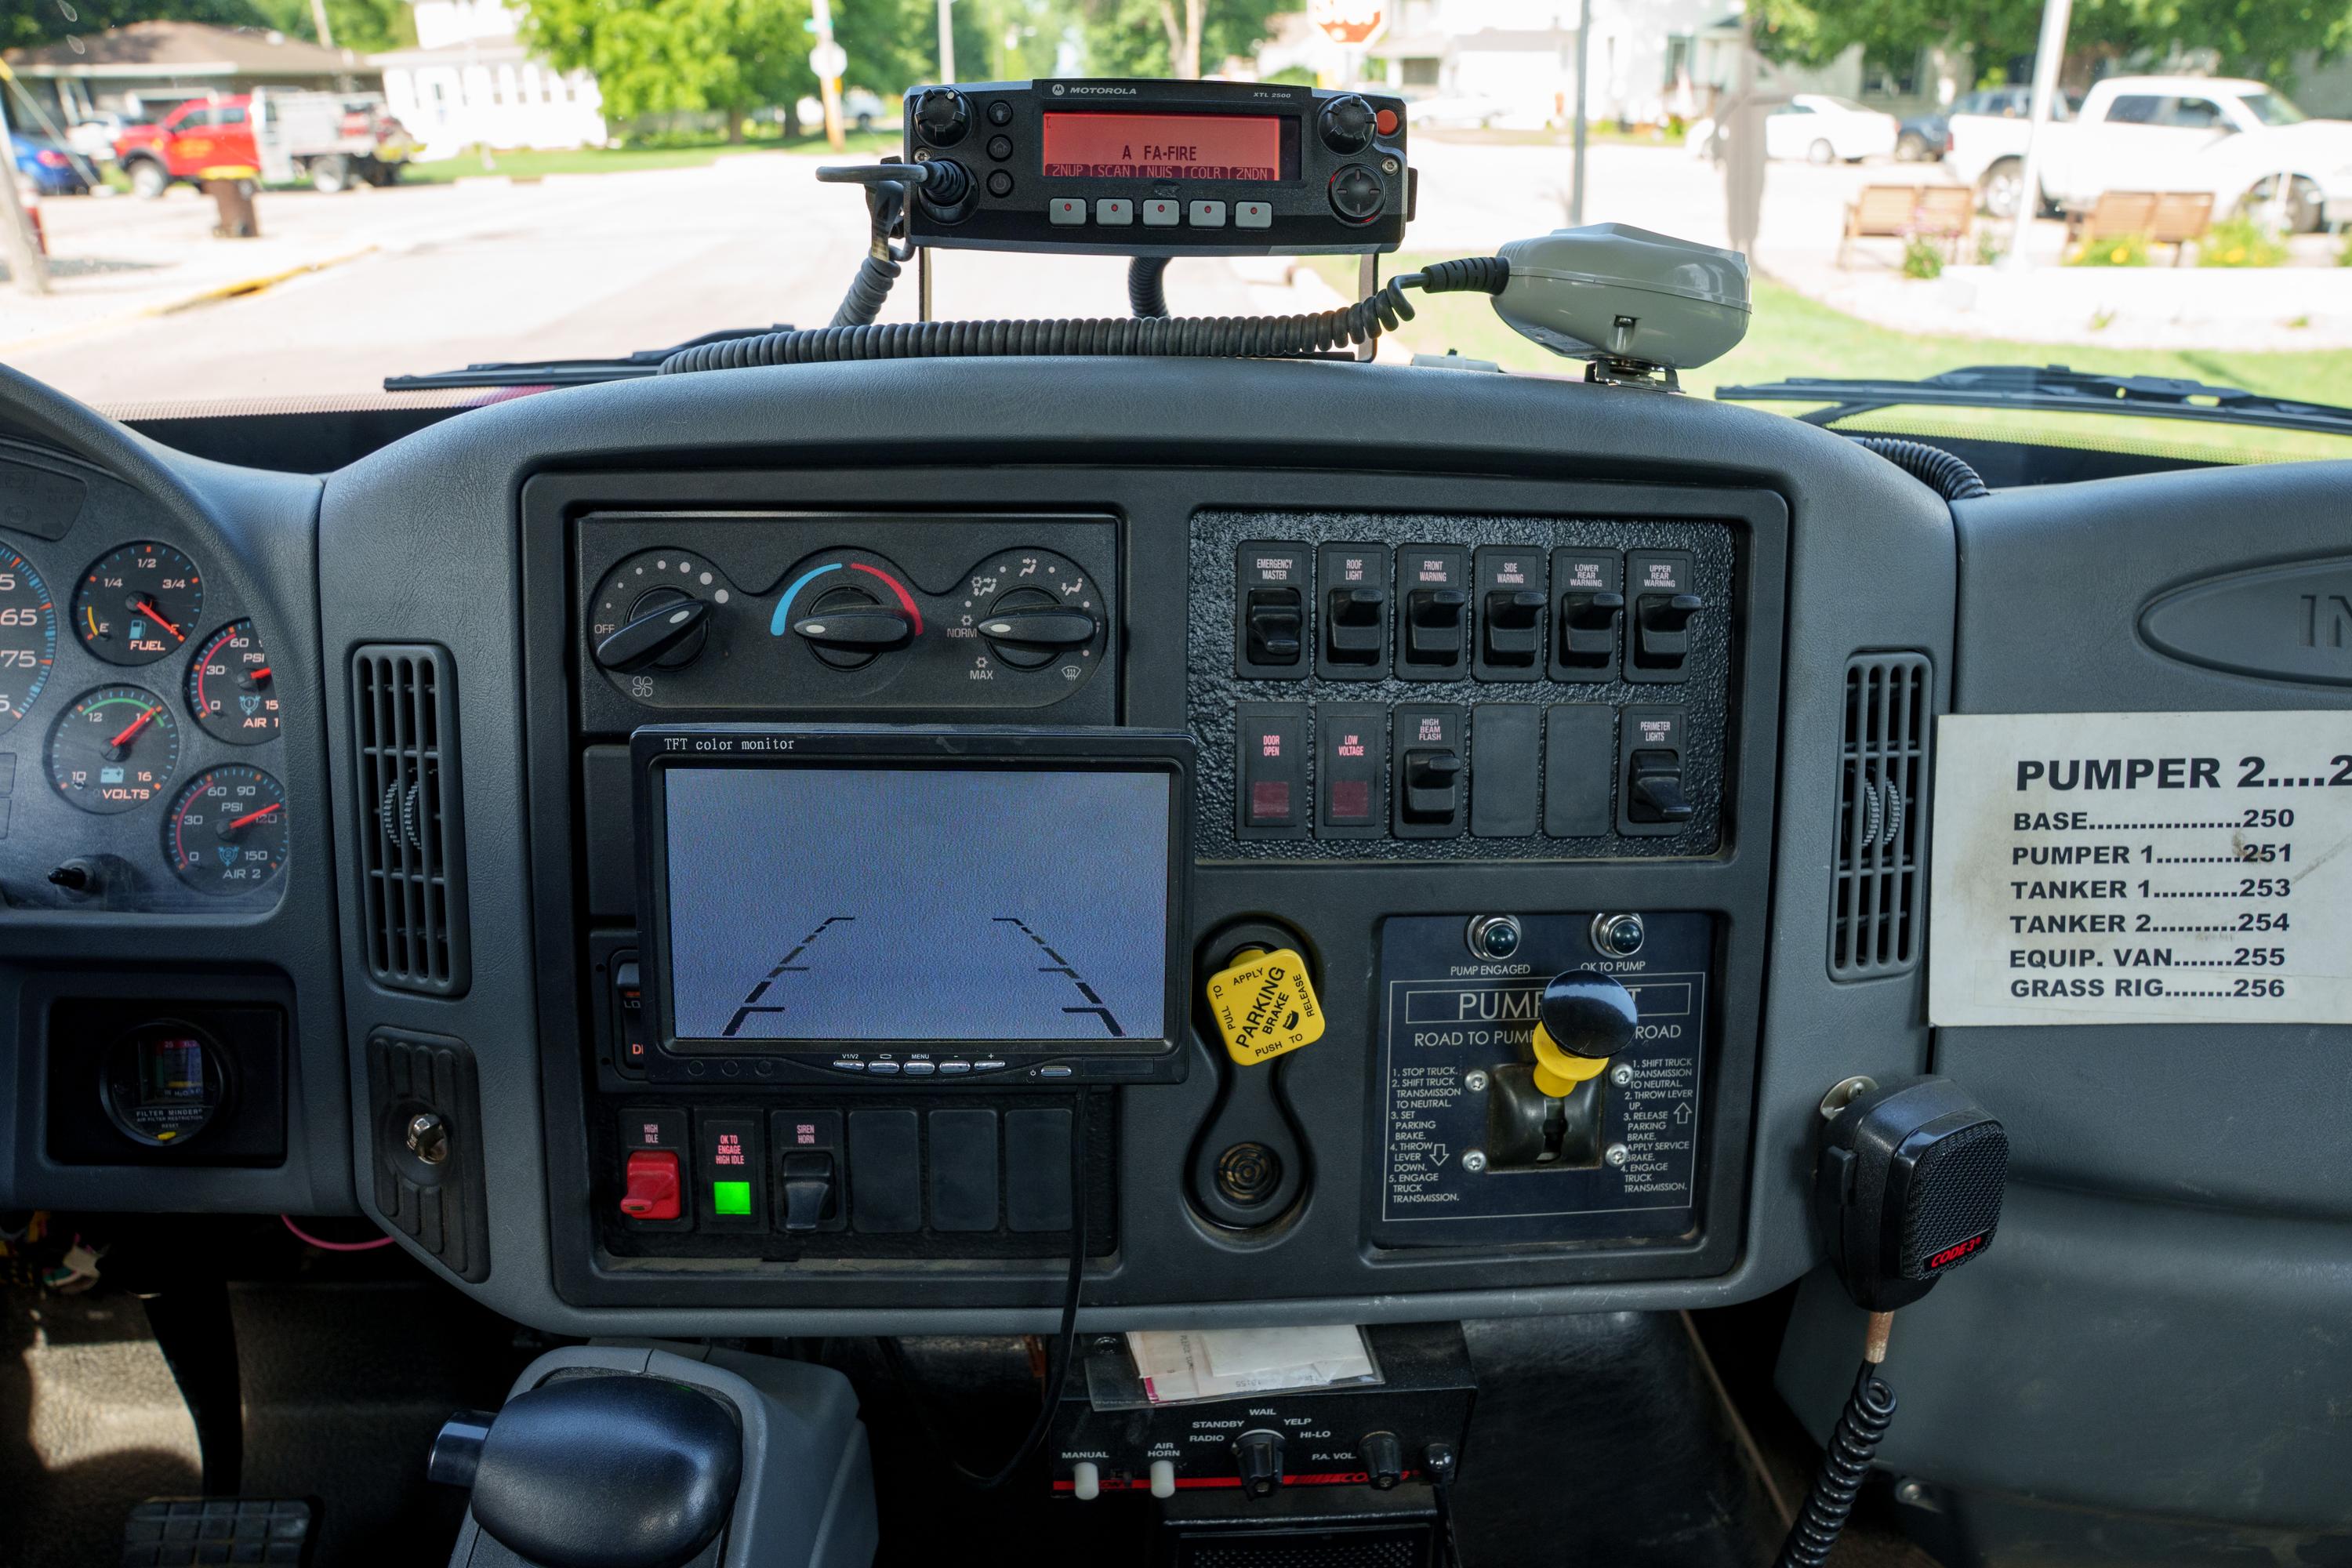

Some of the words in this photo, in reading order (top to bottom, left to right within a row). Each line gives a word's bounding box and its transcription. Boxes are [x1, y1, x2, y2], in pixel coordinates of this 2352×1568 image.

[1123, 145, 1131, 160] A
[1144, 146, 1196, 161] FA-FIRE
[1052, 165, 1083, 177] ZNUP
[1098, 165, 1131, 177] SCAN
[1146, 165, 1173, 179] NUIS
[1190, 166, 1221, 180] COLR
[1236, 168, 1268, 180] ZNDN
[137, 558, 157, 568] 1/2
[1257, 558, 1293, 570] EMERGENCY
[1345, 559, 1363, 570] ROOF
[1424, 560, 1443, 571] FRONT
[1504, 562, 1518, 572] SIDE
[1574, 564, 1599, 572] LOWER
[1650, 564, 1671, 573] UPPER
[1262, 569, 1287, 580] MASTER
[1345, 569, 1363, 580] LIGHT
[1419, 571, 1447, 583] WARNING
[1497, 572, 1524, 584] WARNING
[1577, 571, 1596, 580] REAR
[1650, 572, 1670, 580] REAR
[103, 579, 123, 588] 1/4
[162, 579, 186, 589] 3/4
[1570, 579, 1602, 588] WARNING
[1643, 579, 1676, 588] WARNING
[0, 608, 38, 626] 65
[100, 622, 109, 633] E
[593, 624, 615, 634] OFF
[946, 627, 978, 638] NORM
[130, 641, 165, 651] FUEL
[230, 637, 249, 648] 60
[1, 650, 38, 667] 75
[243, 653, 264, 662] PSI
[206, 665, 225, 675] 30
[969, 670, 993, 681] MAX
[88, 713, 103, 722] 12
[243, 717, 267, 728] AIR
[274, 717, 278, 728] 1
[1640, 720, 1671, 732] PERIMETER
[1262, 735, 1280, 746] DOOR
[1344, 735, 1359, 746] LOW
[1418, 732, 1442, 742] FLASH
[1645, 731, 1665, 742] LIGHTS
[664, 738, 688, 750] TFT
[696, 738, 731, 750] color
[742, 738, 795, 750] monitor
[1263, 746, 1279, 756] OPEN
[1338, 745, 1364, 756] VOLTAGE
[72, 771, 86, 781] 10
[138, 771, 152, 782] 16
[2016, 757, 2221, 791] PUMPER
[102, 789, 150, 799] VOLTS
[207, 786, 227, 797] 60
[237, 786, 256, 796] 90
[221, 803, 242, 812] PSI
[184, 815, 202, 825] 30
[245, 851, 267, 861] 150
[2013, 846, 2130, 866] PUMPER
[223, 869, 245, 879] AIR
[252, 869, 261, 879] 2
[2010, 880, 2128, 900] TANKER
[2009, 914, 2127, 934] TANKER
[2010, 949, 2103, 969] EQUIP.
[1450, 965, 1479, 977] PUMP
[1480, 964, 1530, 975] ENGAGED
[1581, 963, 1597, 971] OK
[1599, 962, 1613, 971] TO
[1617, 961, 1646, 971] PUMP
[1233, 967, 1263, 985] APPLY
[1213, 985, 1224, 1000] TO
[2011, 979, 2104, 997] GRASS
[1293, 974, 1315, 1017] RELEASE
[1236, 967, 1285, 1048] PARKING
[1221, 1005, 1236, 1030] PULL
[1262, 992, 1289, 1035] BRAKE
[1635, 1025, 1682, 1039] ROAD
[1289, 1033, 1303, 1044] TO
[1414, 1031, 1463, 1047] ROAD
[1467, 1031, 1490, 1045] TO
[1255, 1041, 1283, 1057] PUSH
[1665, 1058, 1692, 1066] TRUCK
[1402, 1068, 1425, 1076] STOP
[1427, 1067, 1458, 1076] TRUCK.
[1402, 1079, 1424, 1087] SHIFT
[1426, 1078, 1455, 1087] TRUCK
[1396, 1088, 1461, 1098] TRANSMISSION
[1634, 1091, 1666, 1099] THROW
[1668, 1089, 1693, 1098] LEVER
[1634, 1111, 1668, 1120] RELEASE
[644, 1124, 659, 1133] HIGH
[797, 1124, 814, 1134] SIREN
[1396, 1120, 1436, 1130] PARKING
[1628, 1122, 1667, 1131] PARKING
[645, 1134, 659, 1143] IDLE
[720, 1135, 728, 1144] OK
[730, 1135, 738, 1144] TO
[798, 1135, 814, 1144] HORN
[1396, 1131, 1426, 1141] BRAKE.
[718, 1145, 742, 1154] ENGAGE
[1399, 1142, 1433, 1151] THROW
[1626, 1143, 1653, 1152] APPLY
[1655, 1141, 1690, 1150] SERVICE
[716, 1156, 730, 1164] HIGH
[731, 1156, 745, 1164] IDLE
[1394, 1163, 1427, 1172] DOWN.
[1631, 1163, 1668, 1172] ENGAGE
[1399, 1173, 1439, 1182] ENGAGE
[1625, 1174, 1652, 1182] TRUCK
[1393, 1184, 1422, 1192] TRUCK
[1624, 1182, 1687, 1193] TRANSMISSION.
[1393, 1193, 1460, 1203] TRANSMISSION.
[1932, 1242, 1968, 1268] CODE
[1192, 1420, 1244, 1428] STANDBY
[1283, 1417, 1312, 1426] YELP
[1300, 1430, 1331, 1439] HI-LO
[1062, 1450, 1109, 1459] MANUAL
[1147, 1449, 1181, 1457] HORN
